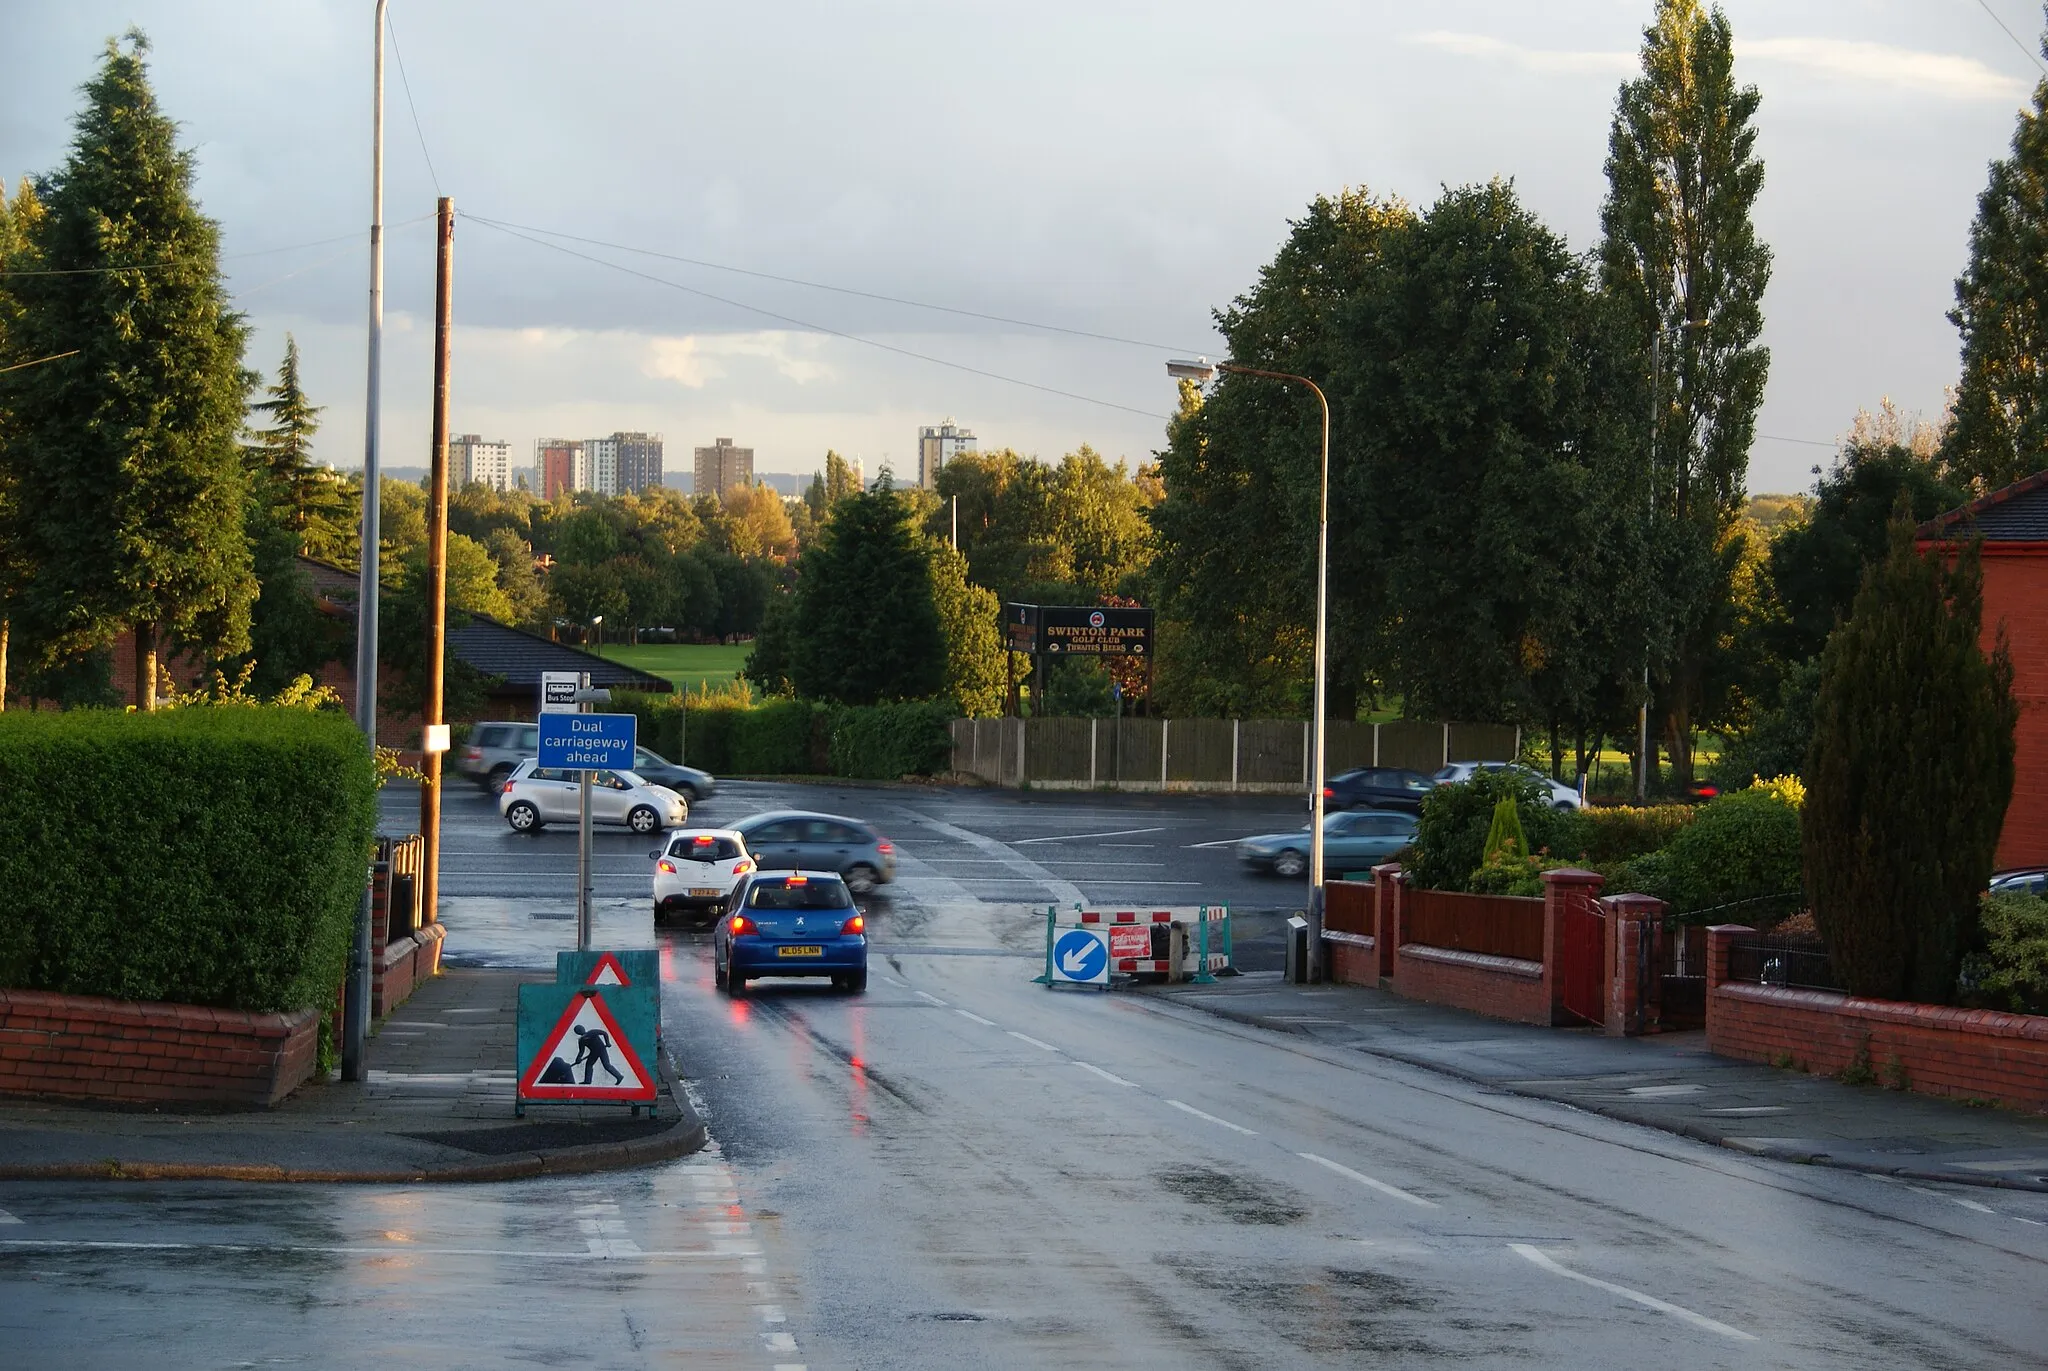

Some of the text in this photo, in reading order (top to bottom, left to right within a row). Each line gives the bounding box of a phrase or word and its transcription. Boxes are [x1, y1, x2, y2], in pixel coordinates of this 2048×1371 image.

[1048, 626, 1107, 637] SWINTON
[1110, 627, 1145, 637] PARK
[1102, 644, 1127, 652] BEERS
[547, 694, 575, 703] Bus Stop
[571, 719, 603, 733] Dual
[545, 735, 628, 751] carriageway
[566, 750, 608, 763] ahead
